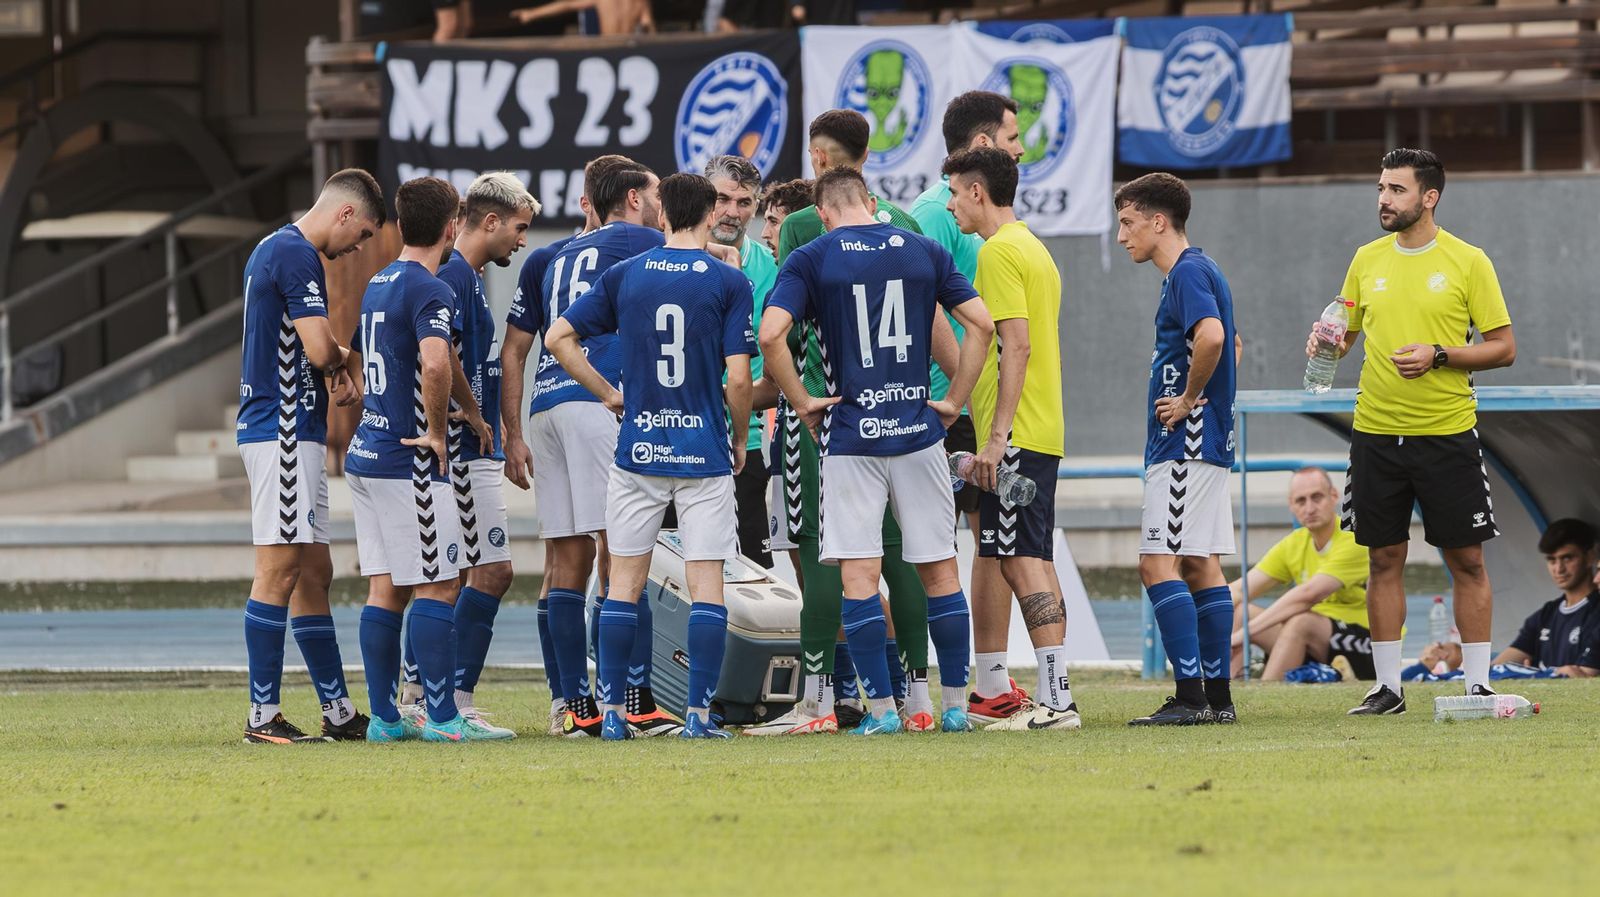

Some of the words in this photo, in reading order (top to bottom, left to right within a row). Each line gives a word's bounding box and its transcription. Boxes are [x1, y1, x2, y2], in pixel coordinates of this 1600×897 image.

[387, 57, 560, 150] MKS
[574, 55, 660, 147] 23
[549, 247, 599, 326] 16
[645, 258, 689, 272] indeso
[361, 311, 387, 396] 15
[655, 303, 685, 388] 3
[852, 279, 912, 369] 14
[653, 454, 705, 464] ProNutrition
[881, 423, 928, 437] ProNutrition
